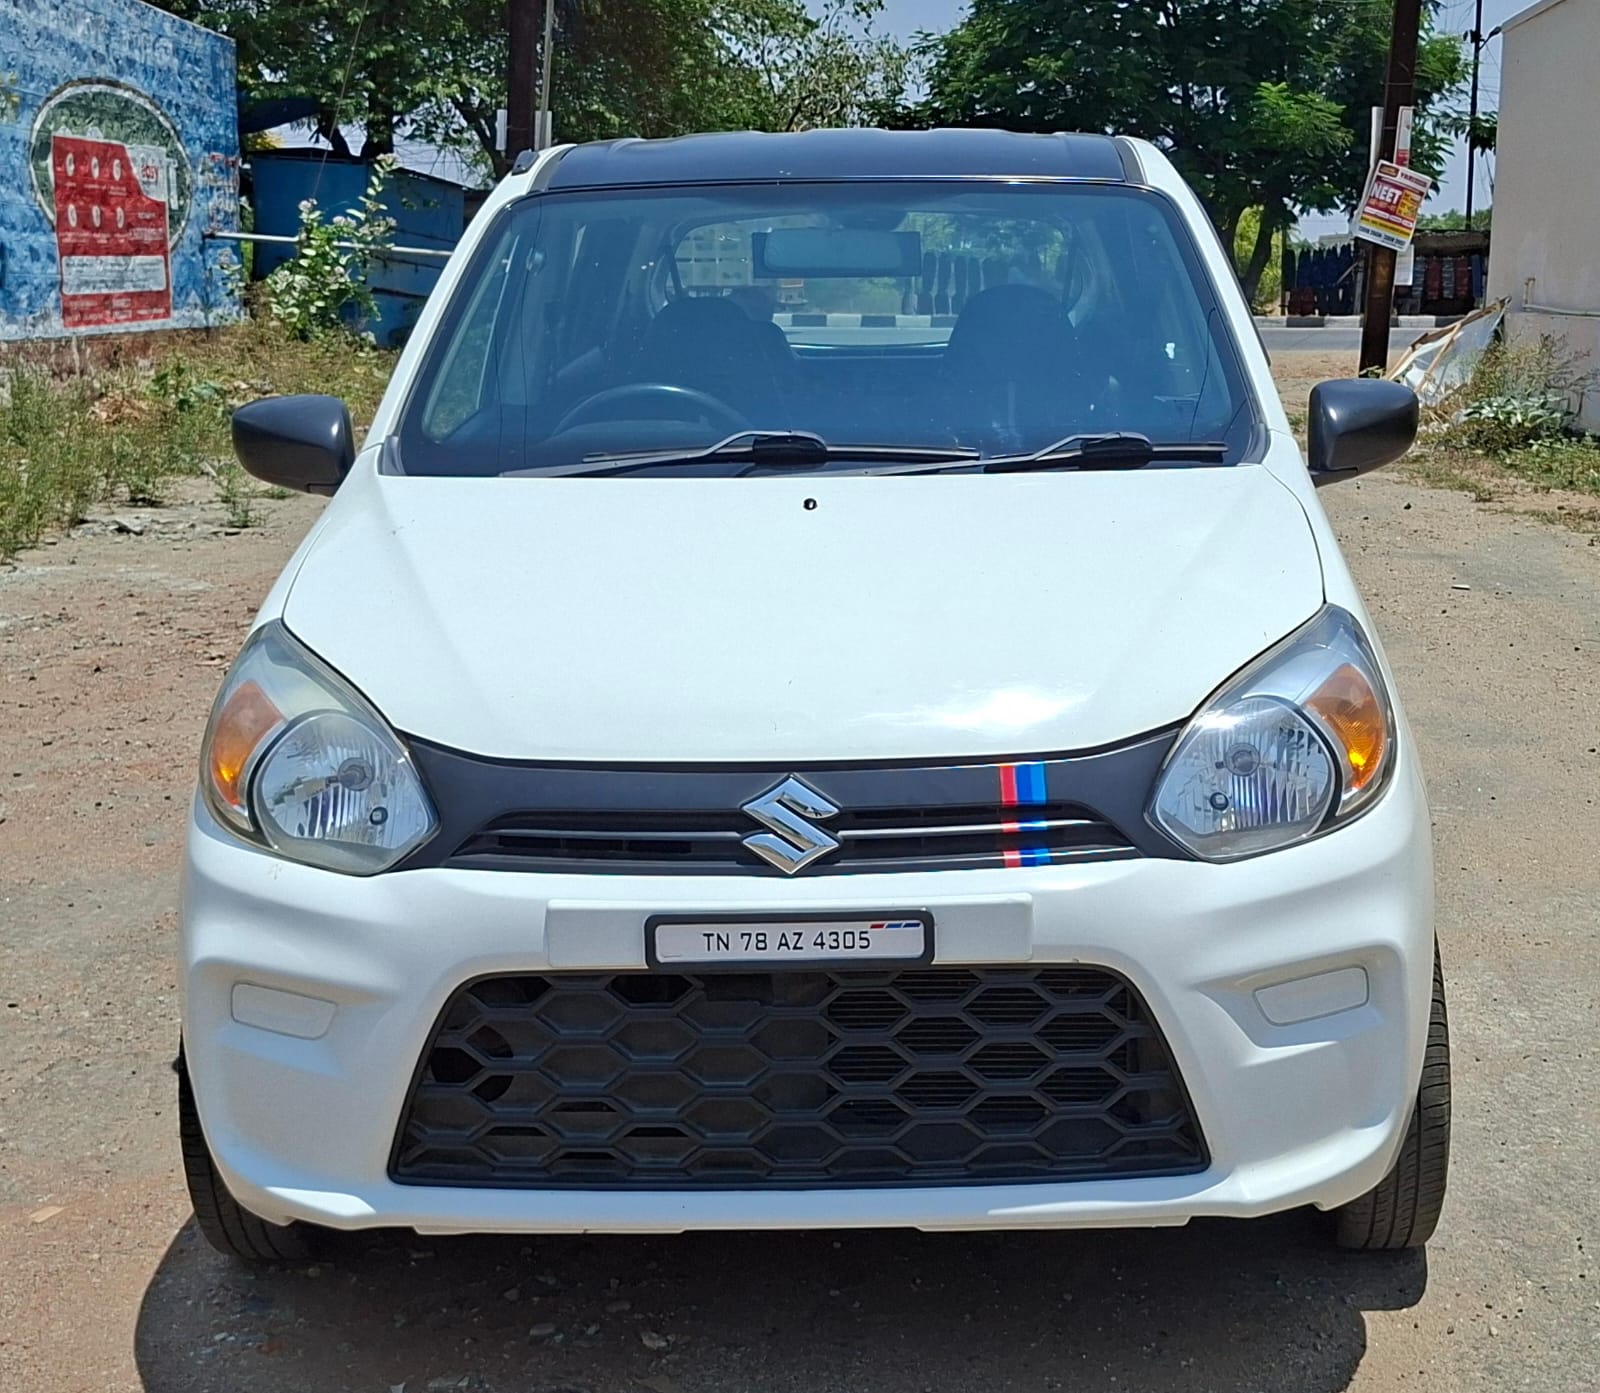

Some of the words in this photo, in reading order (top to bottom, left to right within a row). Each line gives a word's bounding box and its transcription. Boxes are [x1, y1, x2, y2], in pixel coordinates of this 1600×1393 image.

[1371, 182, 1402, 205] NEET
[703, 932, 729, 951] TN
[740, 932, 767, 951] 78
[777, 931, 803, 950] AZ
[813, 930, 870, 949] 4305
